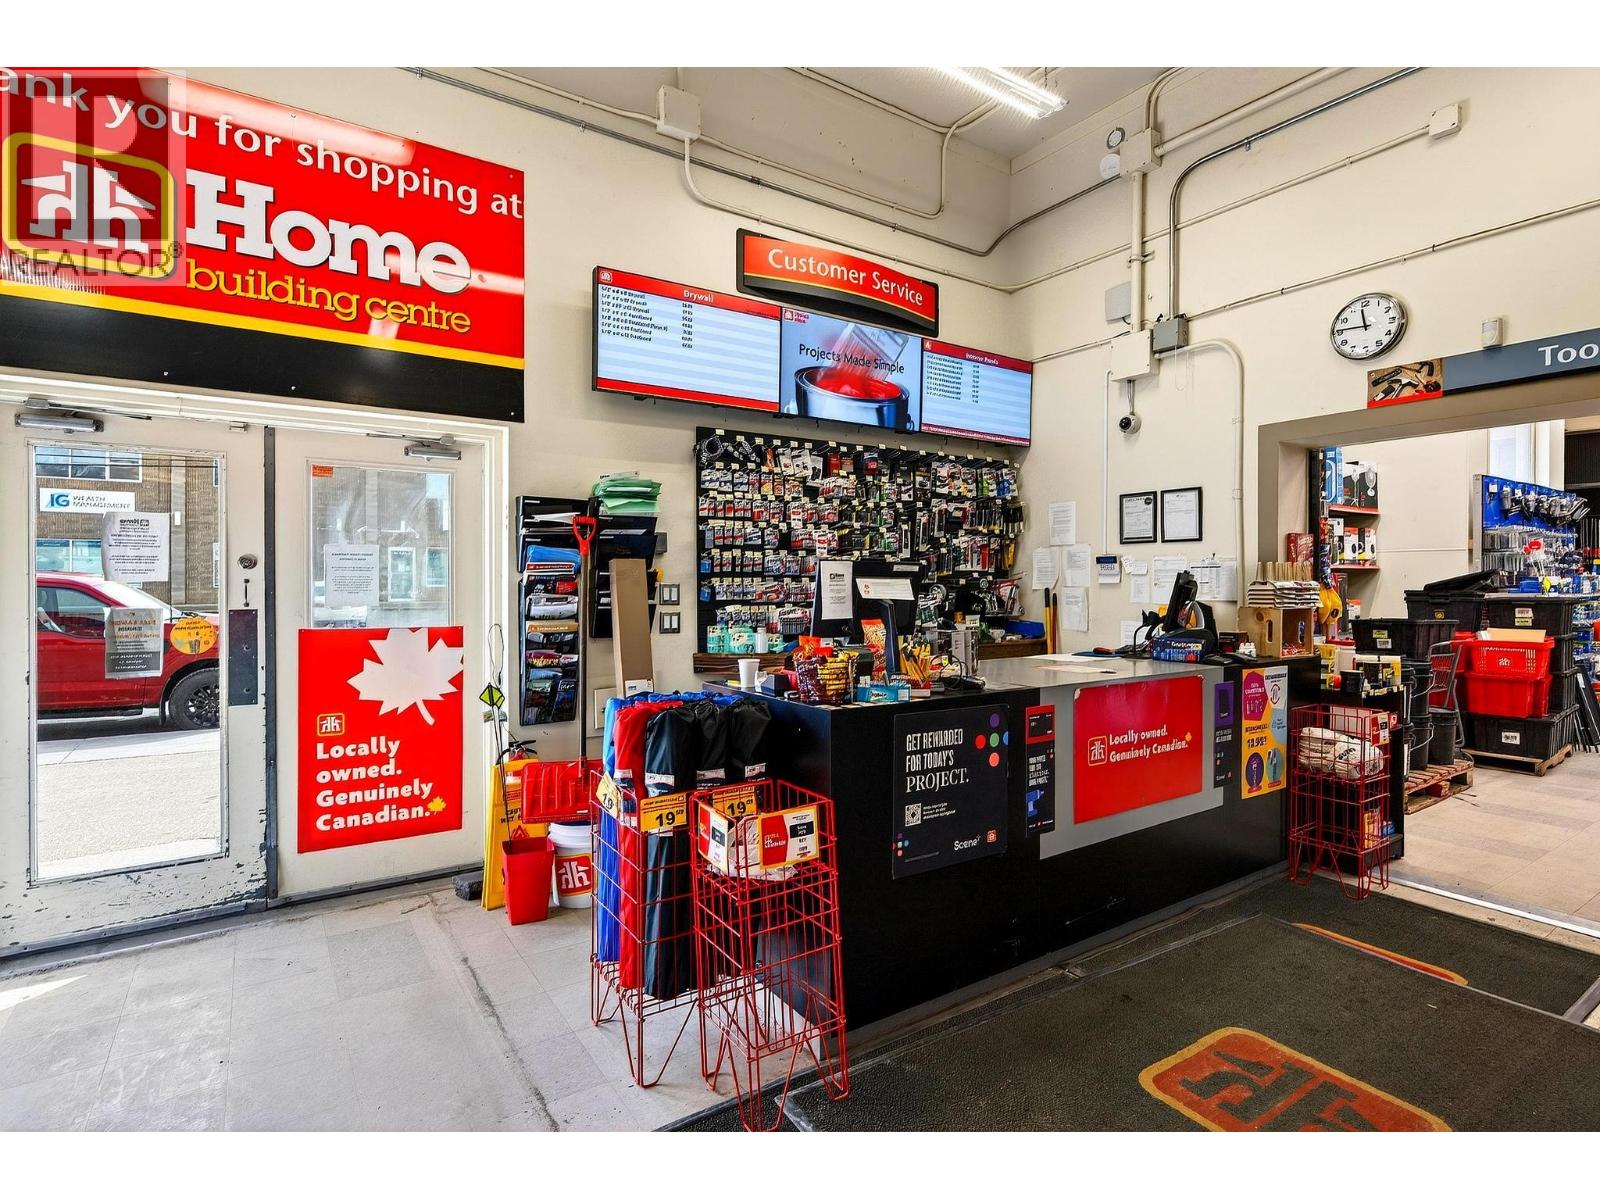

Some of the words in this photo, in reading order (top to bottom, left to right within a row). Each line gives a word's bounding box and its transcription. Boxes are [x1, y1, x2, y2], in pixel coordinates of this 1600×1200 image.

[104, 94, 198, 138] you
[214, 114, 283, 157] for
[296, 138, 479, 216] shopping
[489, 188, 524, 220] at
[185, 166, 472, 294] Home
[767, 247, 867, 287] Customer
[871, 270, 923, 306] Service
[185, 258, 362, 323] building
[364, 295, 472, 335] centre
[683, 289, 714, 303] Drywall
[799, 343, 841, 361] Projects
[843, 353, 872, 368] Made
[874, 358, 905, 375] Simple
[1537, 343, 1599, 367] Too
[50, 493, 70, 507] IG
[316, 735, 401, 760] Locally
[906, 733, 922, 752] GET
[922, 728, 964, 750] REWARDED
[1109, 729, 1139, 746] Locally
[1140, 724, 1168, 740] owned.
[906, 754, 922, 773] FOR
[922, 749, 955, 770] TODAY'S
[1109, 744, 1151, 763] Genuinely
[1152, 738, 1189, 754] Canadian.
[316, 758, 402, 784] owned.
[905, 767, 969, 793] PROJECT.
[316, 778, 433, 808] Genuinely
[315, 804, 431, 832] Canadian.
[656, 811, 676, 827] 19
[726, 801, 747, 816] 19
